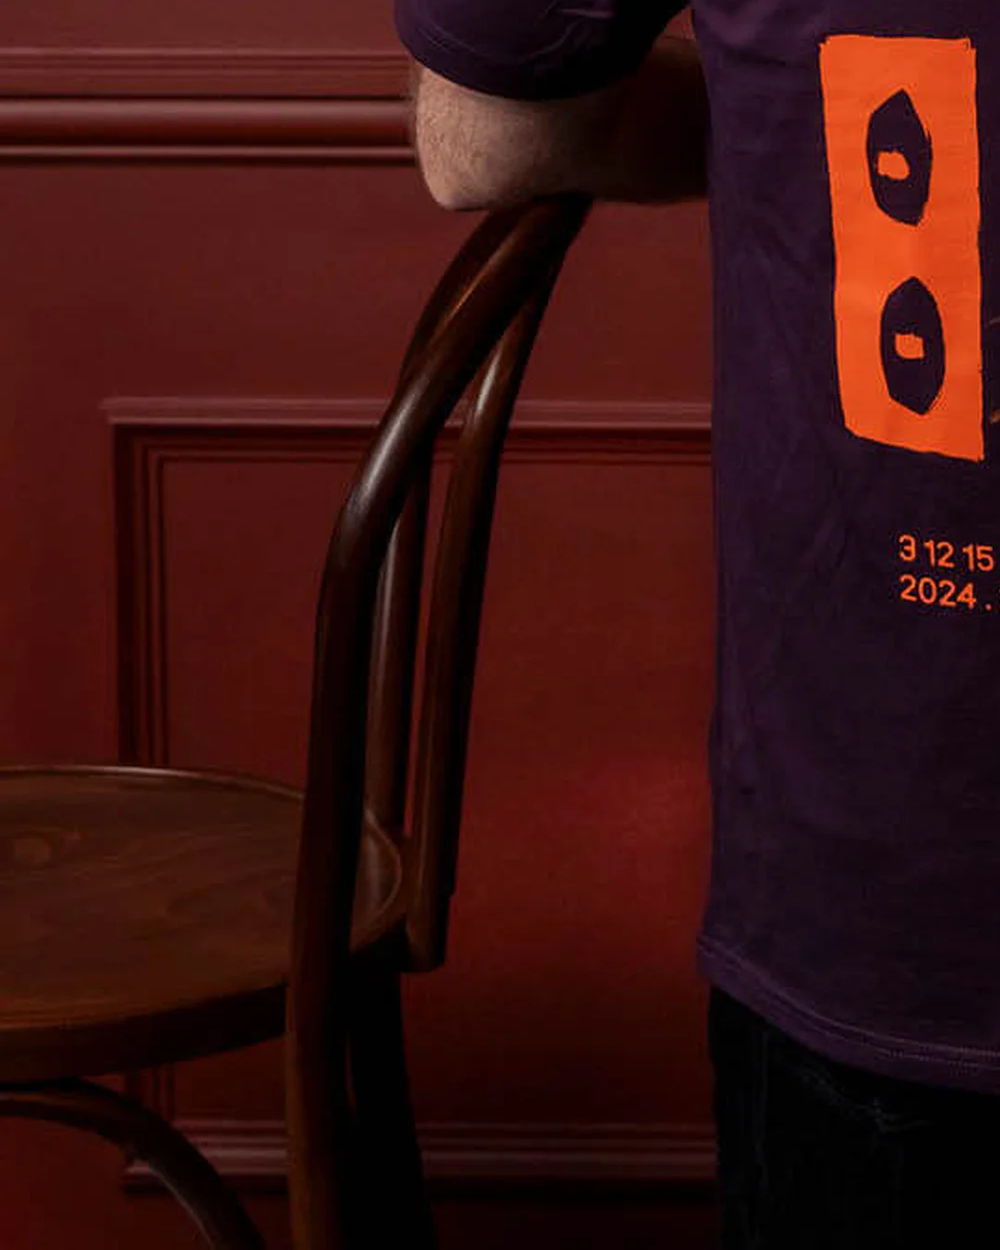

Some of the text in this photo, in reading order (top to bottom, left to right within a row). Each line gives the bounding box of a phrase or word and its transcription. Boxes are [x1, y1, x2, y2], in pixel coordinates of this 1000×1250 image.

[899, 534, 917, 562] 3
[923, 539, 955, 569] 12
[961, 543, 995, 572] 15
